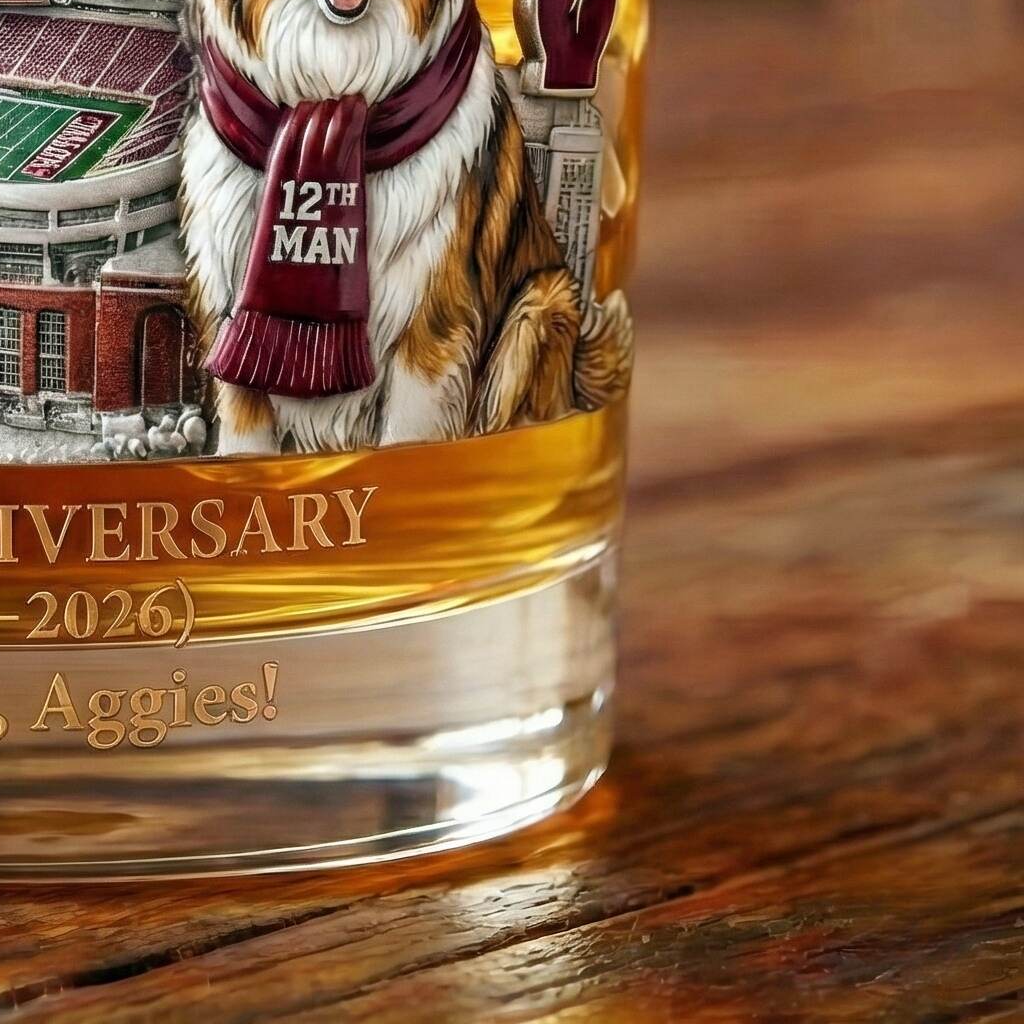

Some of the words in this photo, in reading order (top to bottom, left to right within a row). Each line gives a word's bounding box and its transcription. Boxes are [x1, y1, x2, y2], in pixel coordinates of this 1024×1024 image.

[279, 179, 359, 221] 12TH
[270, 225, 359, 265] MAN
[30, 661, 279, 750] Aggies!
